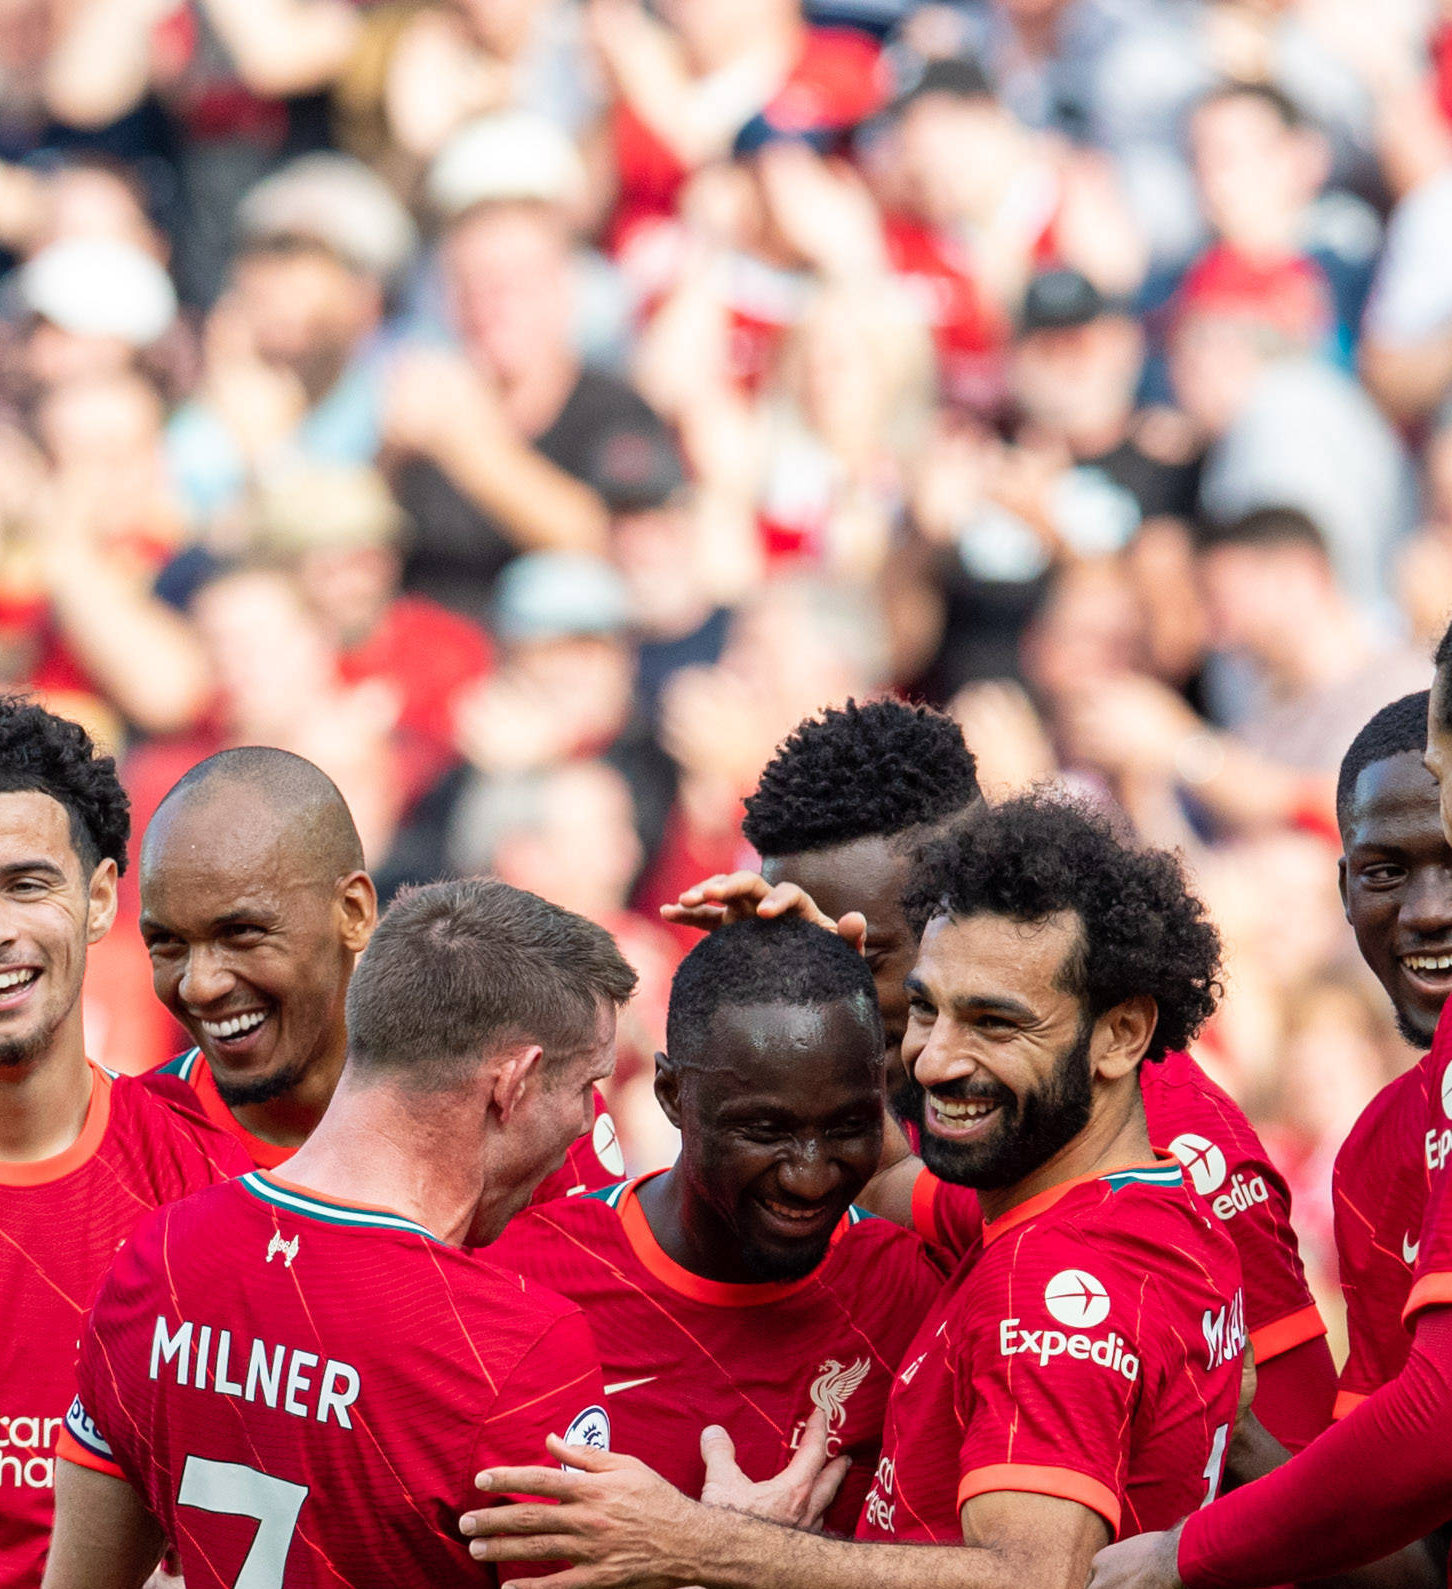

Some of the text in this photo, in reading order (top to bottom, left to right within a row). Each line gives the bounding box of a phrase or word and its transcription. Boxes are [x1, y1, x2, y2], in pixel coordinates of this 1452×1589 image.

[1213, 1174, 1269, 1220] edia
[149, 1315, 361, 1430] MILNER
[999, 1318, 1140, 1381] Expedia
